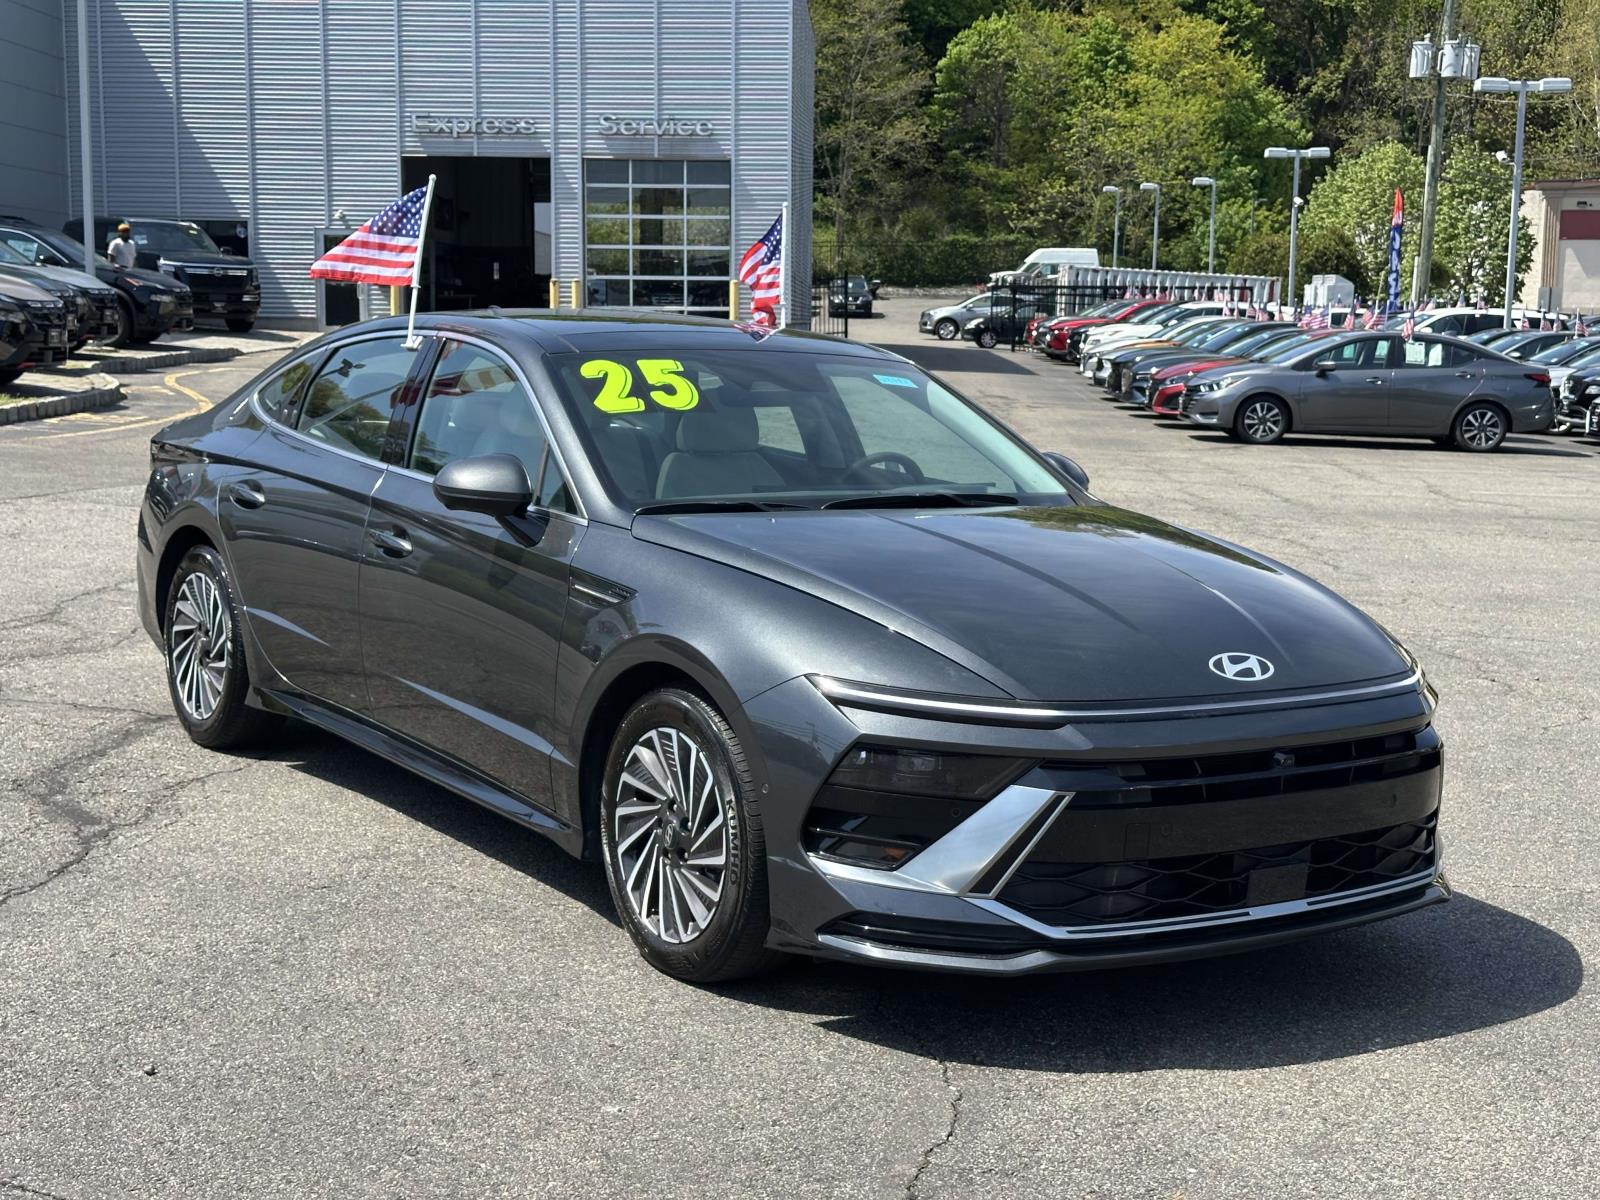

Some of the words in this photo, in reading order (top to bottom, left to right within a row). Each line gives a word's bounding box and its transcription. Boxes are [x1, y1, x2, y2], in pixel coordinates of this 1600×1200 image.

[411, 112, 536, 137] Express
[600, 114, 713, 136] Service
[580, 359, 699, 413] 25
[726, 798, 739, 885] KUMHO
